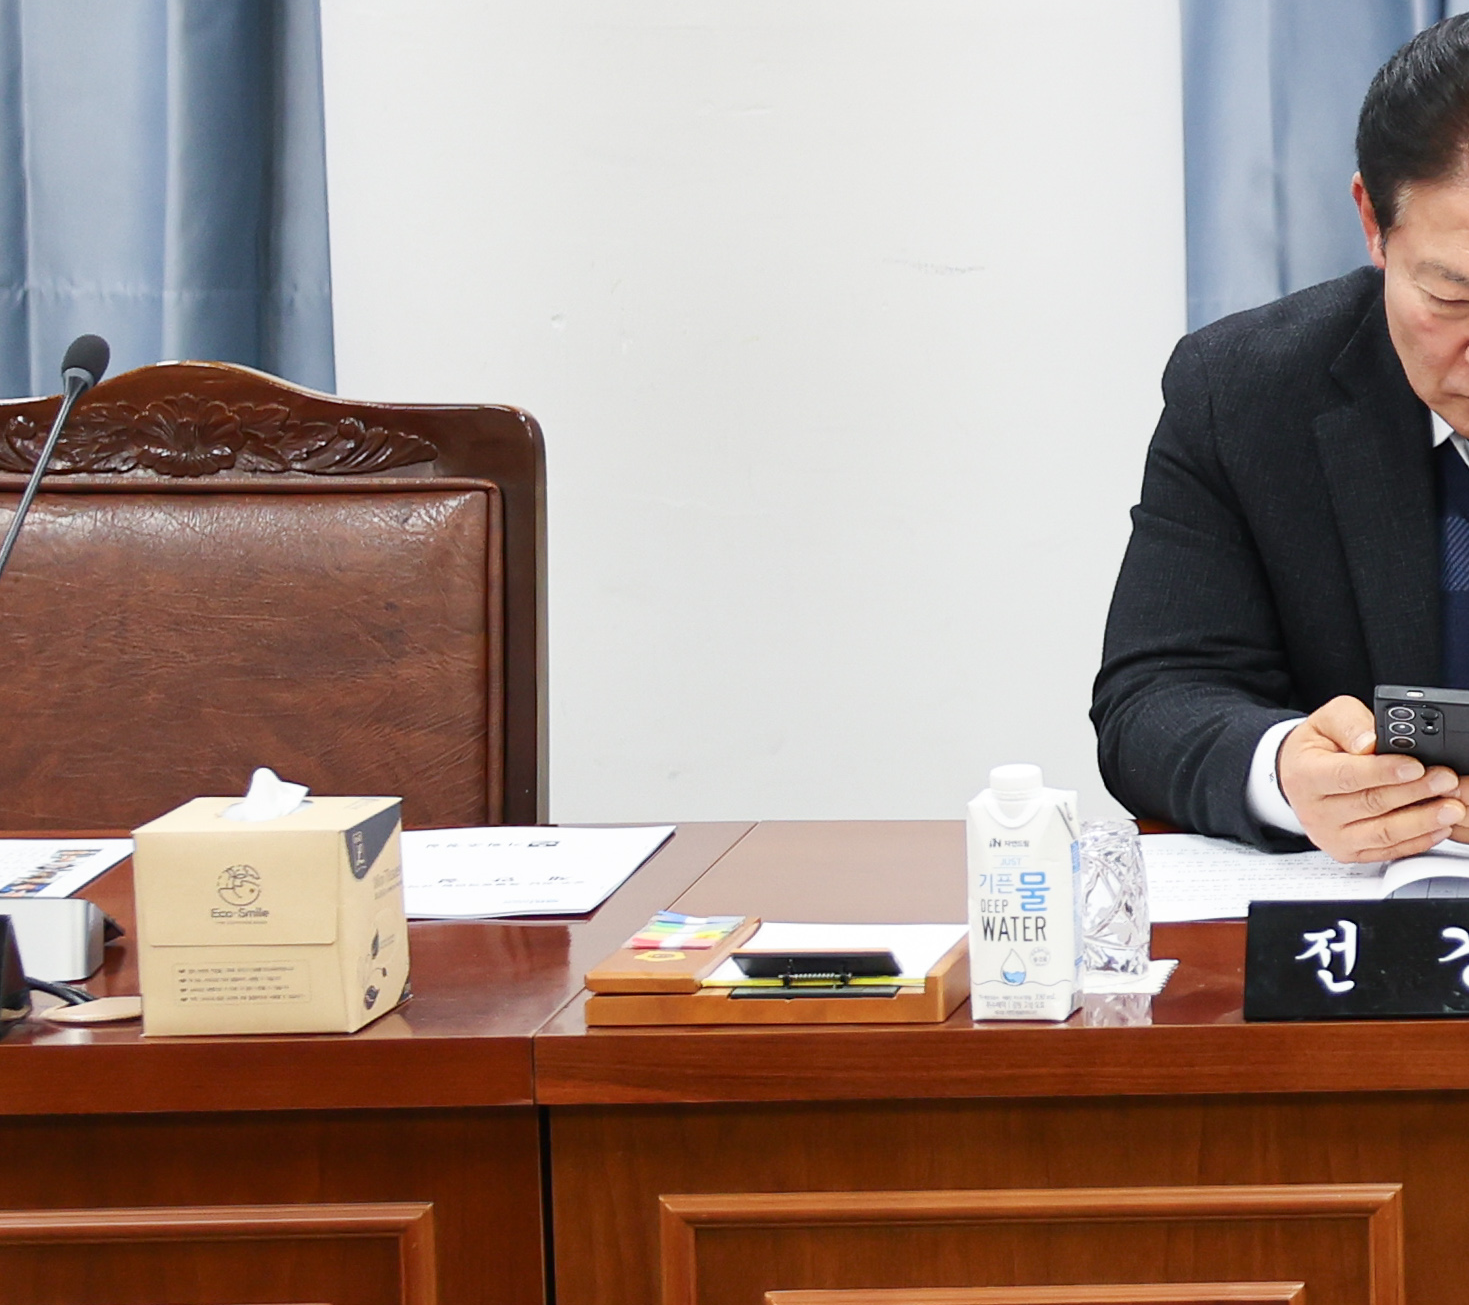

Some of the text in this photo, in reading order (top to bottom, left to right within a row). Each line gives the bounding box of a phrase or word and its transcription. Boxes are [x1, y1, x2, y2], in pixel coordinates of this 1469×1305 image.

[1000, 858, 1022, 866] JUST
[980, 899, 1009, 913] DEEP
[982, 916, 1047, 942] WATER
